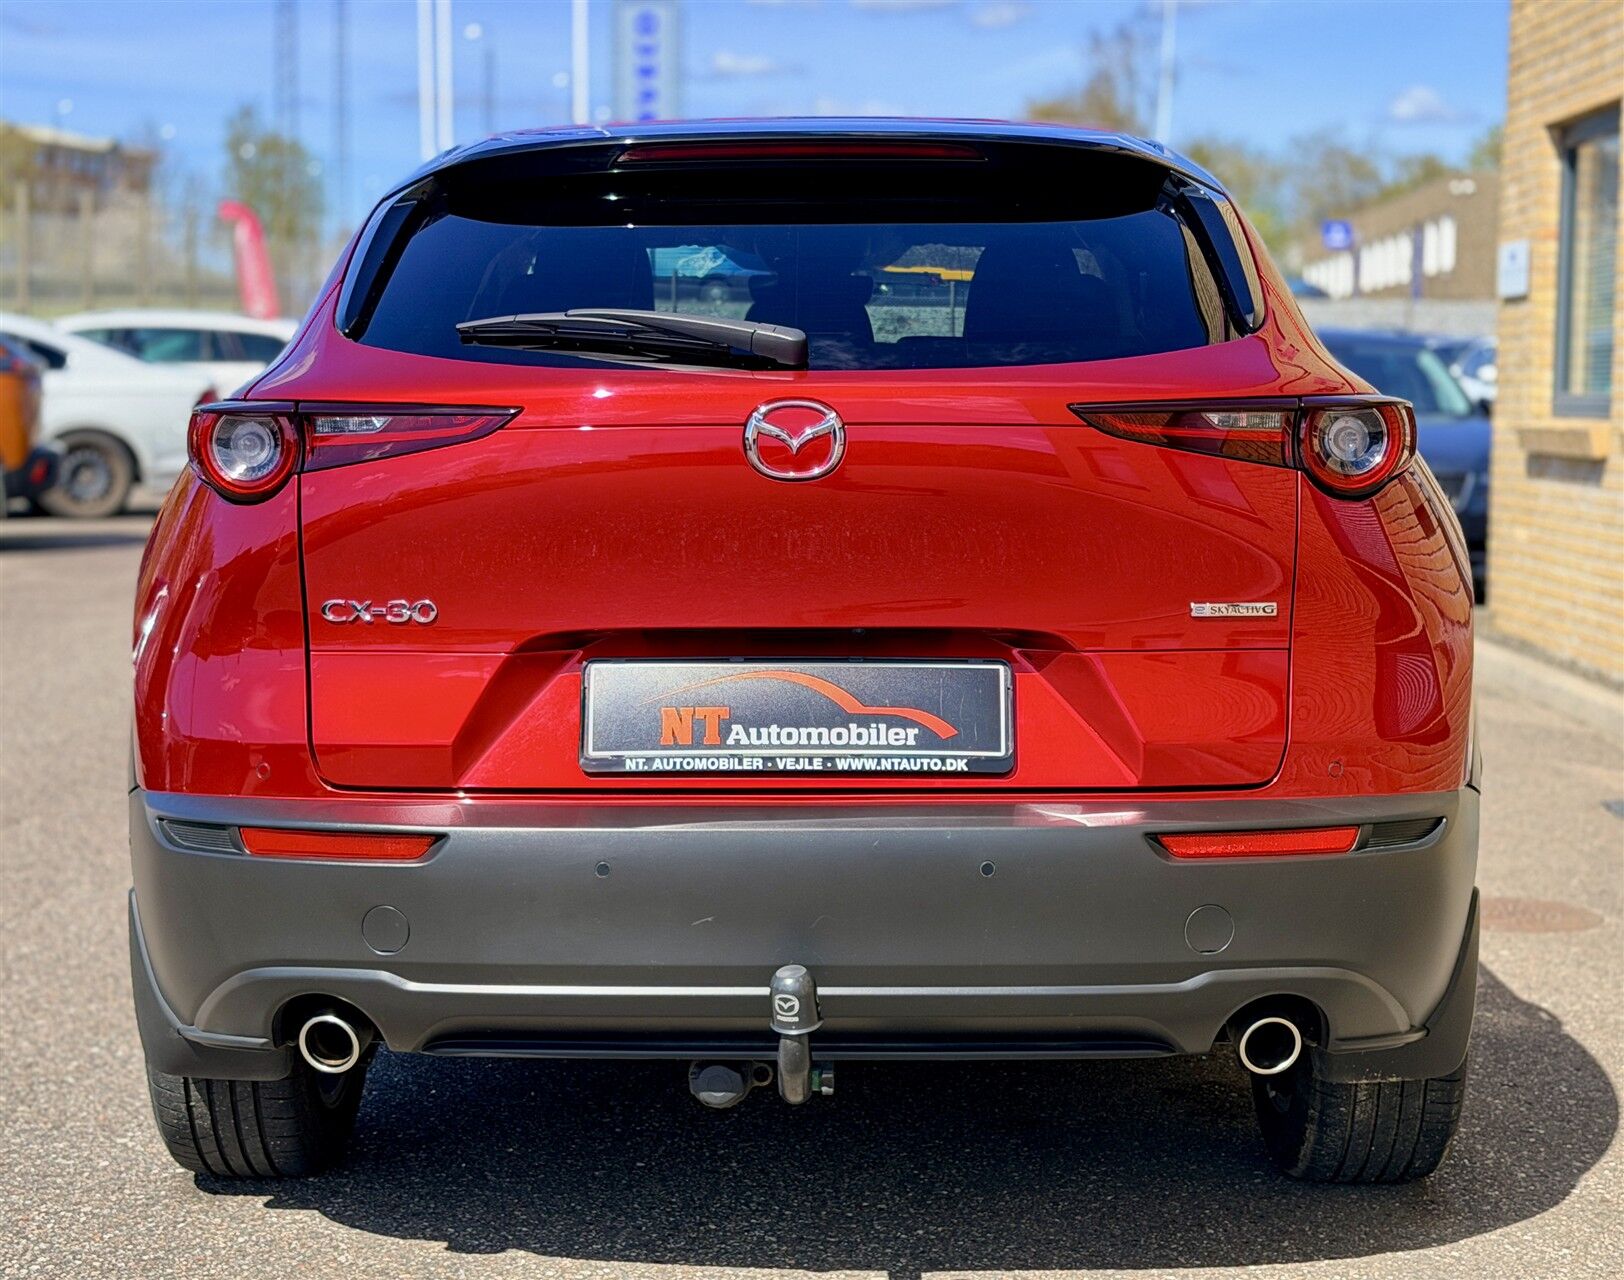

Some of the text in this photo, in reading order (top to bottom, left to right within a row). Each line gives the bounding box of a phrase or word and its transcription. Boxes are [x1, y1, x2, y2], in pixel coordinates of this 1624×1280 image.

[321, 599, 438, 623] CX-30
[659, 706, 919, 746] NT Automobiler
[625, 757, 969, 771] NT. AUTOMOBILER VEJLE WWW.NTAUTO.DK
